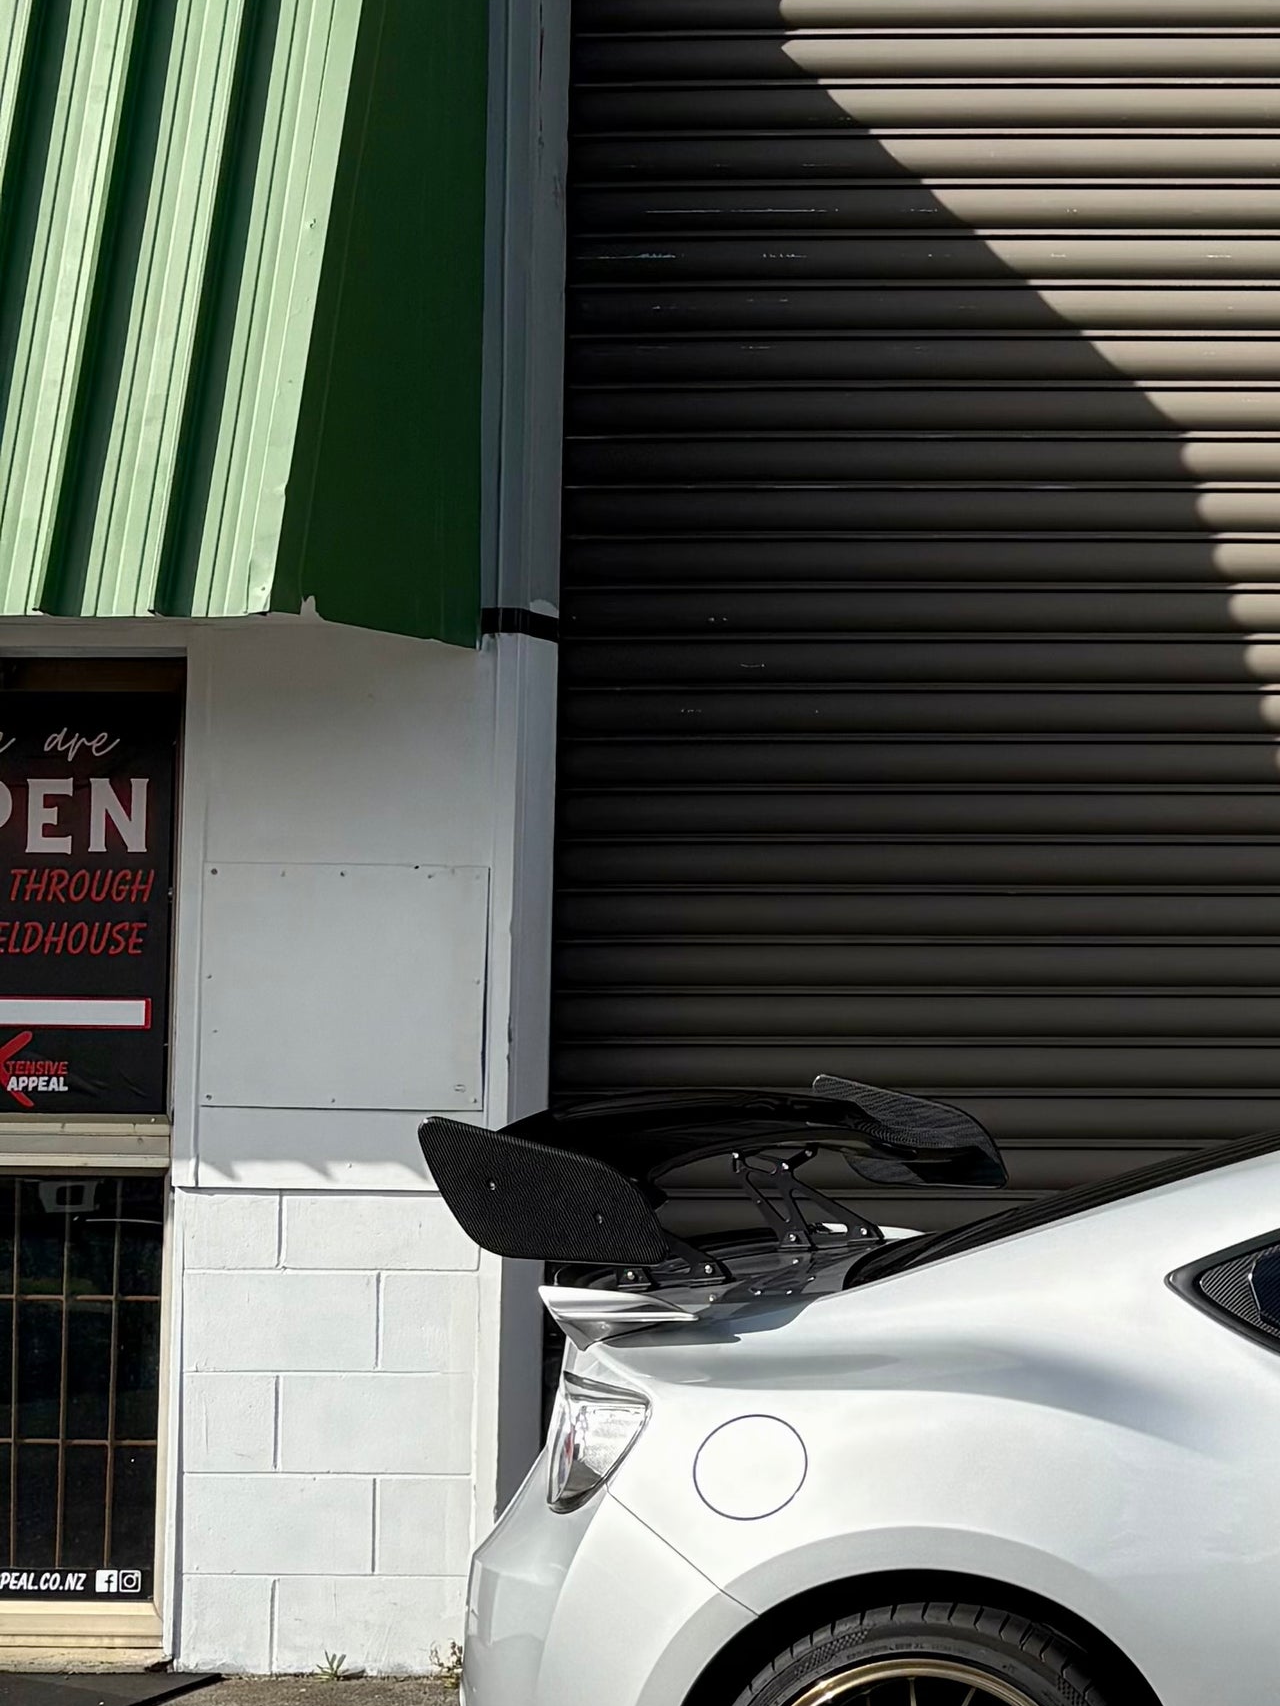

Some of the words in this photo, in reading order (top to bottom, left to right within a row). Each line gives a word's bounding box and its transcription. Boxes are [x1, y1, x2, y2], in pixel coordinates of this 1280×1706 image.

[44, 727, 120, 762] are
[9, 868, 155, 904] THROUGH
[6, 1076, 69, 1092] APPEAL
